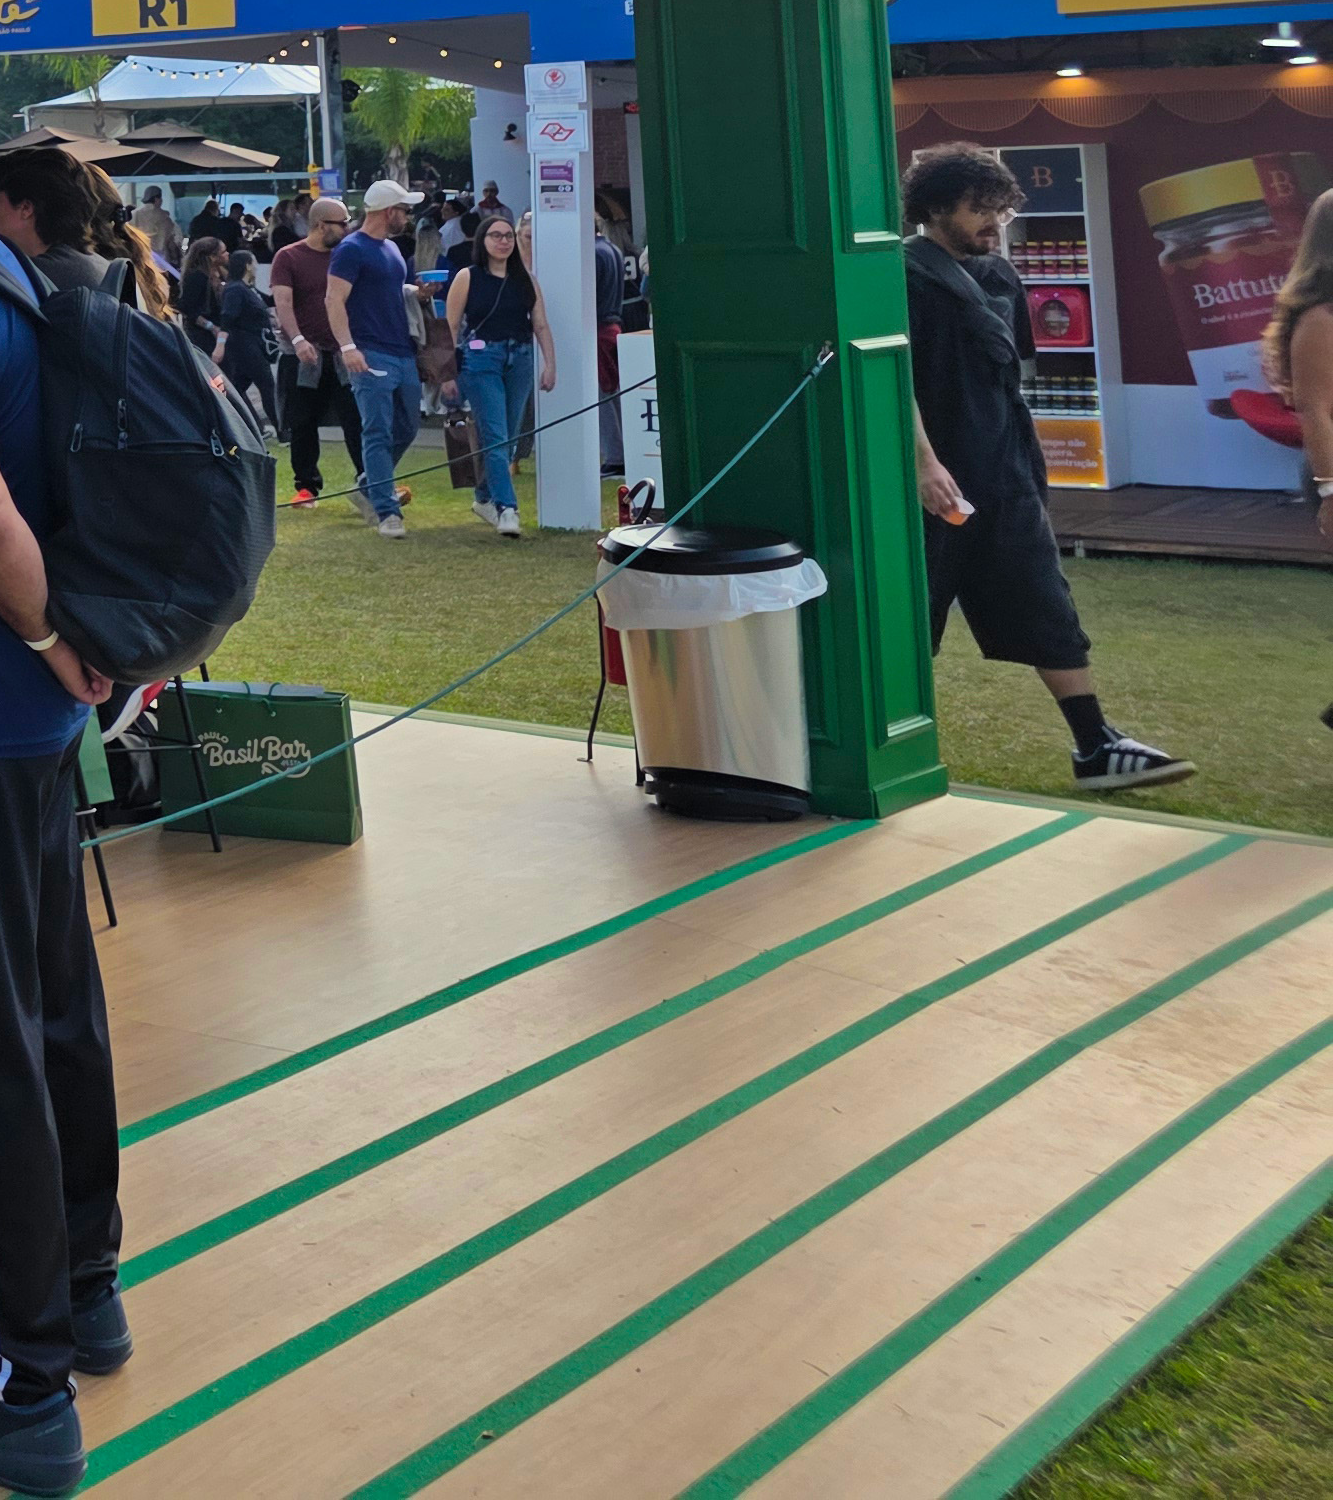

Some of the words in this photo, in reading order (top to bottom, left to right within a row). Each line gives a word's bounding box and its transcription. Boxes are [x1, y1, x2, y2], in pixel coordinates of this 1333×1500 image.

[198, 731, 229, 744] PAULO
[203, 738, 262, 767] Basil
[260, 735, 311, 761] Bar
